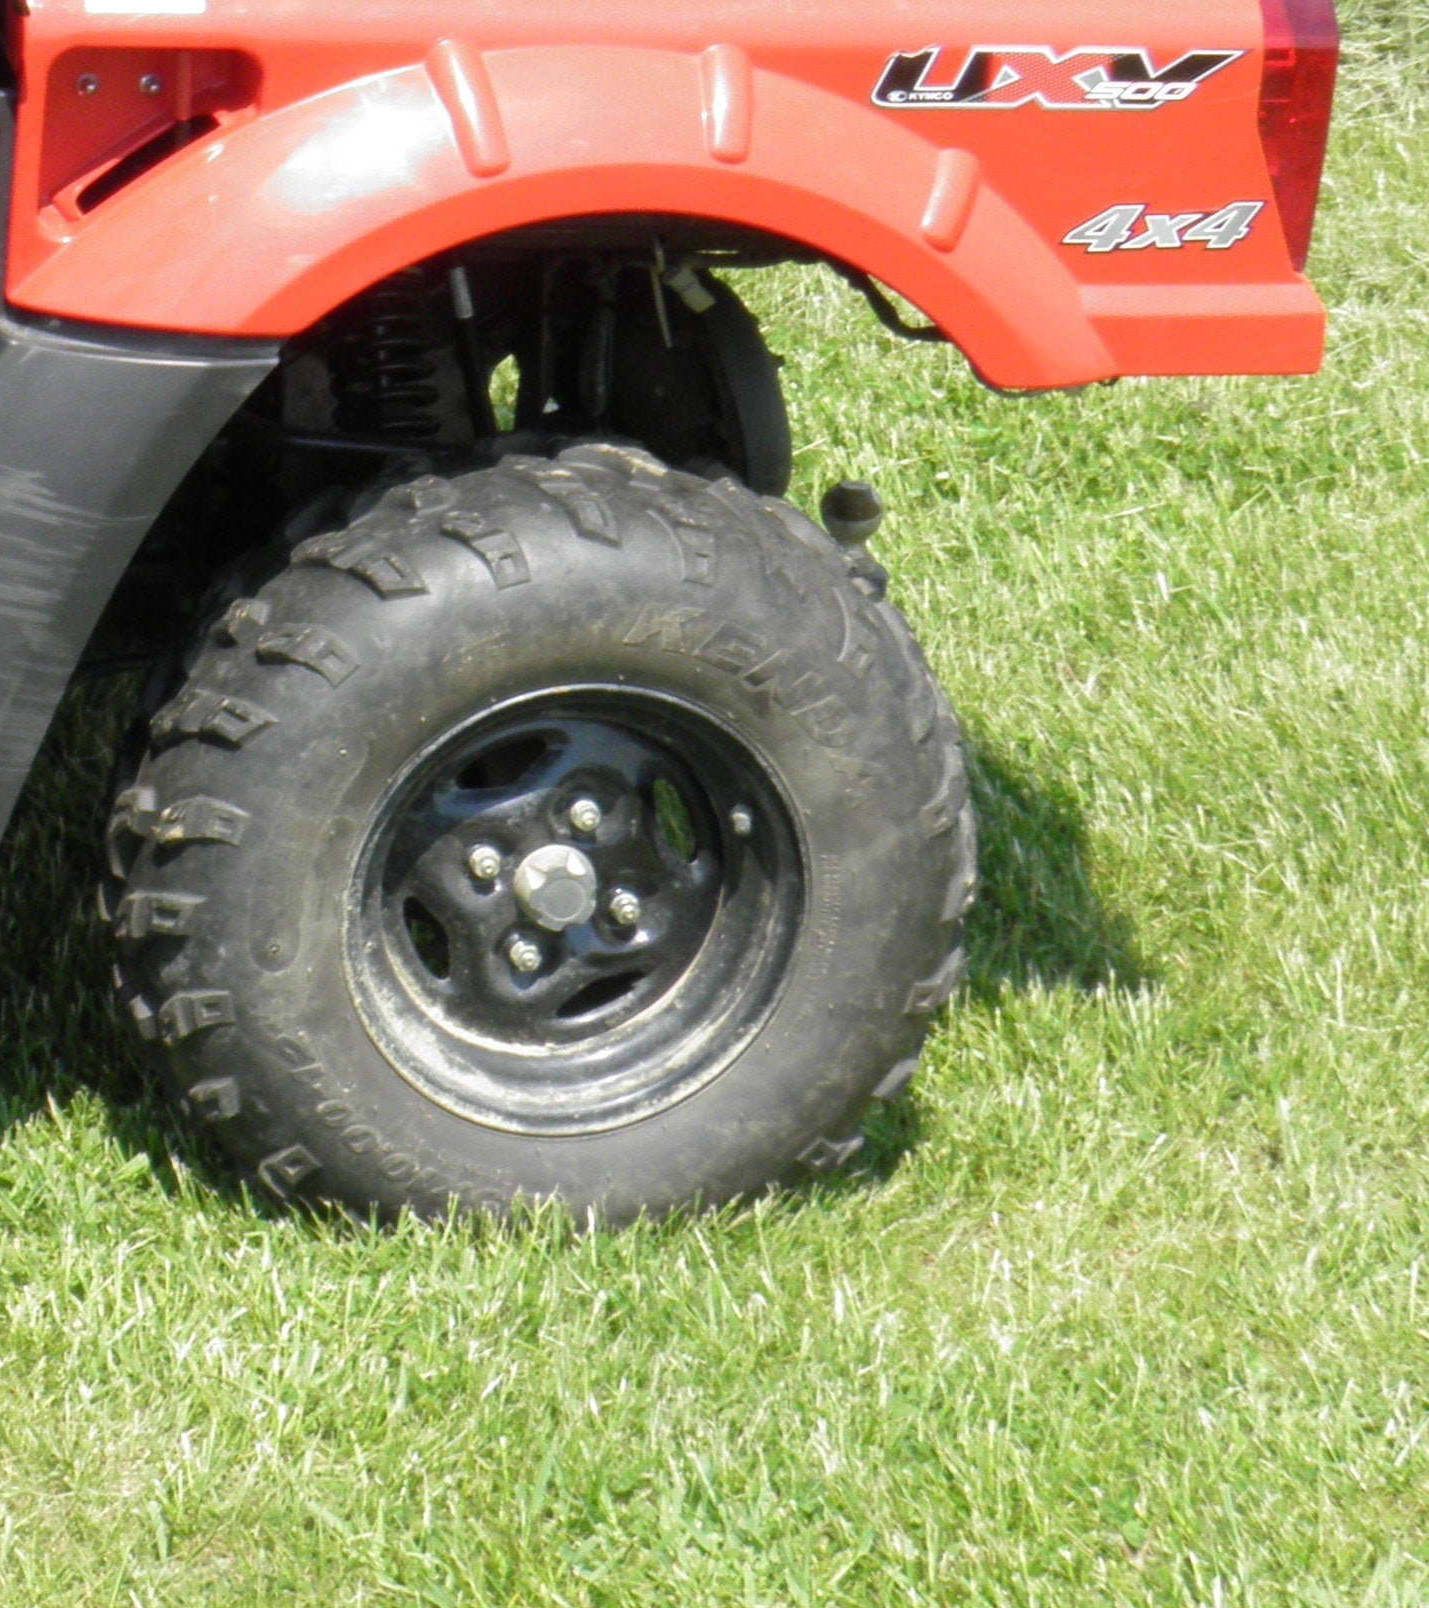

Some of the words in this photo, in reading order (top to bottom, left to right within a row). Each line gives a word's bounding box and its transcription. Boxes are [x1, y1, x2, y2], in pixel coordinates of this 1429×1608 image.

[872, 45, 1247, 110] UXV
[1086, 80, 1199, 101] 500
[908, 91, 953, 101] KYMCO
[1062, 201, 1267, 252] 4x4
